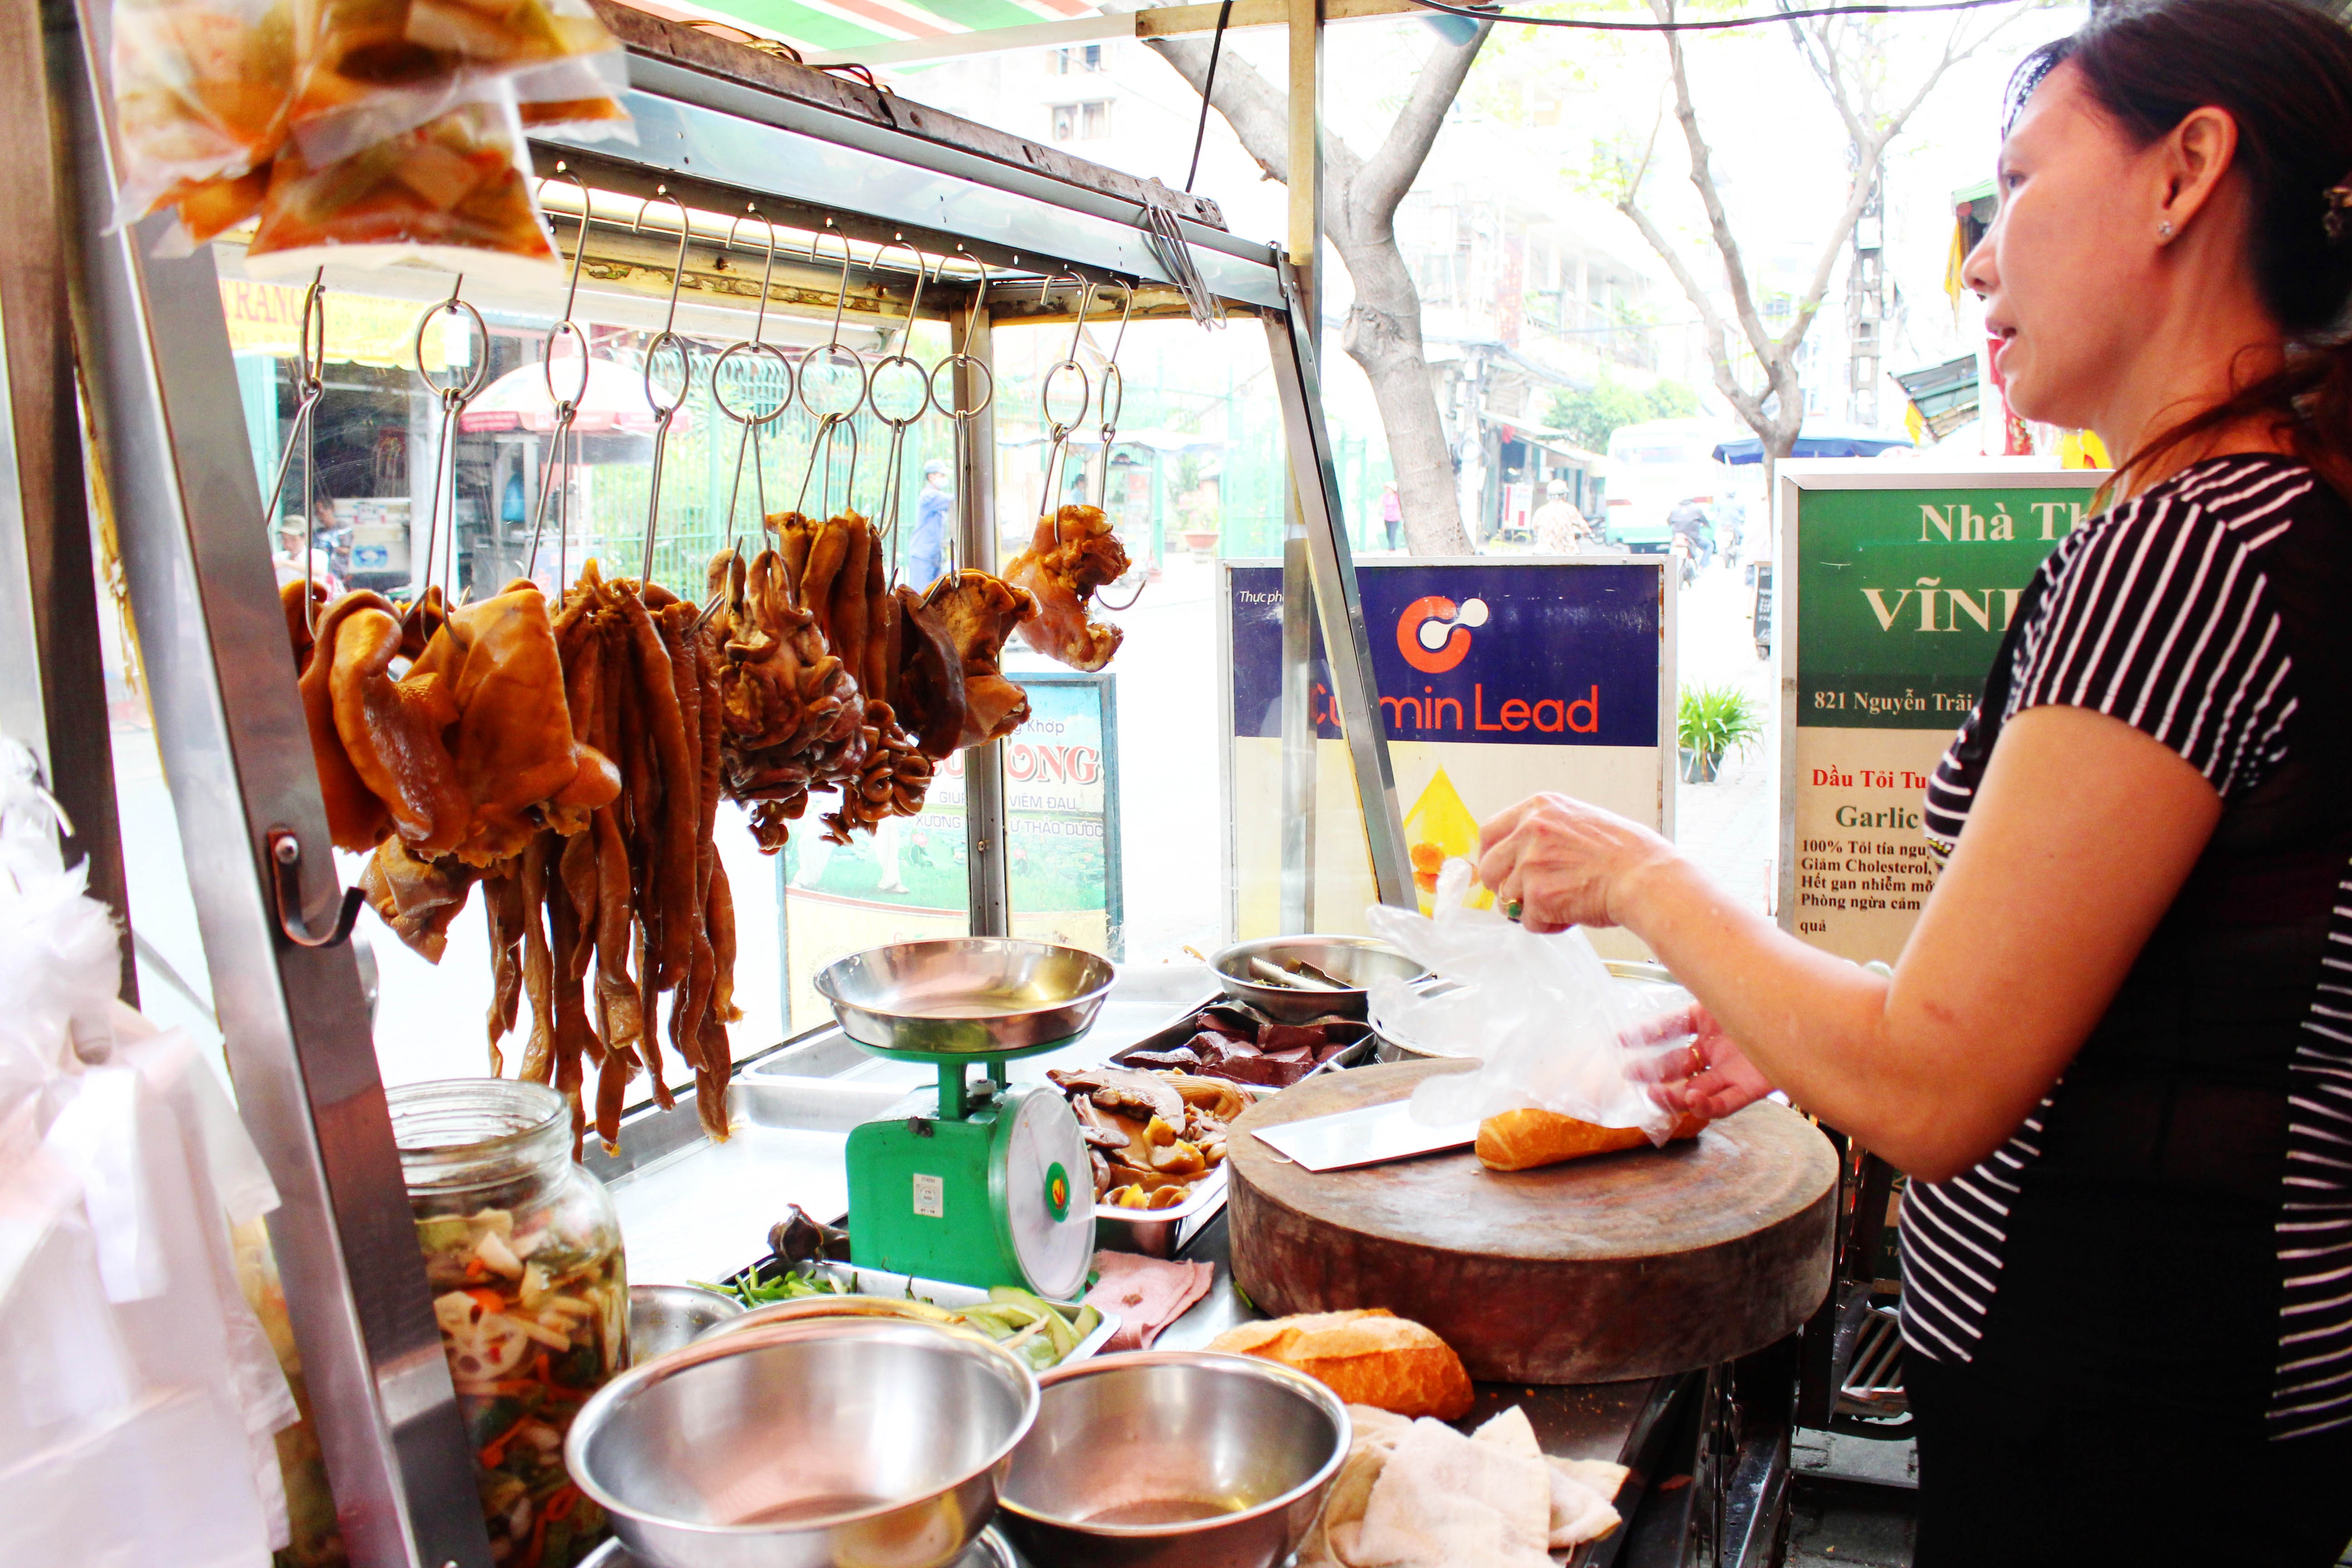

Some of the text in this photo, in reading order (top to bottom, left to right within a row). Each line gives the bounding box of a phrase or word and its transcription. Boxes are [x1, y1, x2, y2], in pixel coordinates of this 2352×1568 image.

[1917, 503, 2015, 542] Nhà
[1240, 590, 1284, 605] Thực ph
[1475, 683, 1598, 733] Lead
[1814, 688, 1973, 715] 821 Nguyễn Trãi
[1028, 719, 1064, 736] Khớp
[1812, 764, 1853, 787] Dầu
[1860, 770, 1894, 788] Tỏi
[1009, 793, 1042, 808] VIÊM
[1046, 797, 1076, 810] ĐAU
[1024, 816, 1061, 834] THẢO
[1836, 805, 1919, 829] Garlic
[1802, 839, 1930, 859] 100% Tỏi tía ngu
[1801, 857, 1932, 875] Giảm Cholesterol,
[1801, 872, 1827, 889] Hết
[1831, 880, 1857, 892] gan
[1862, 876, 1906, 892] nhiễm
[1801, 892, 1920, 911] Phòng ngừa cảm
[1800, 919, 1826, 934] quả
